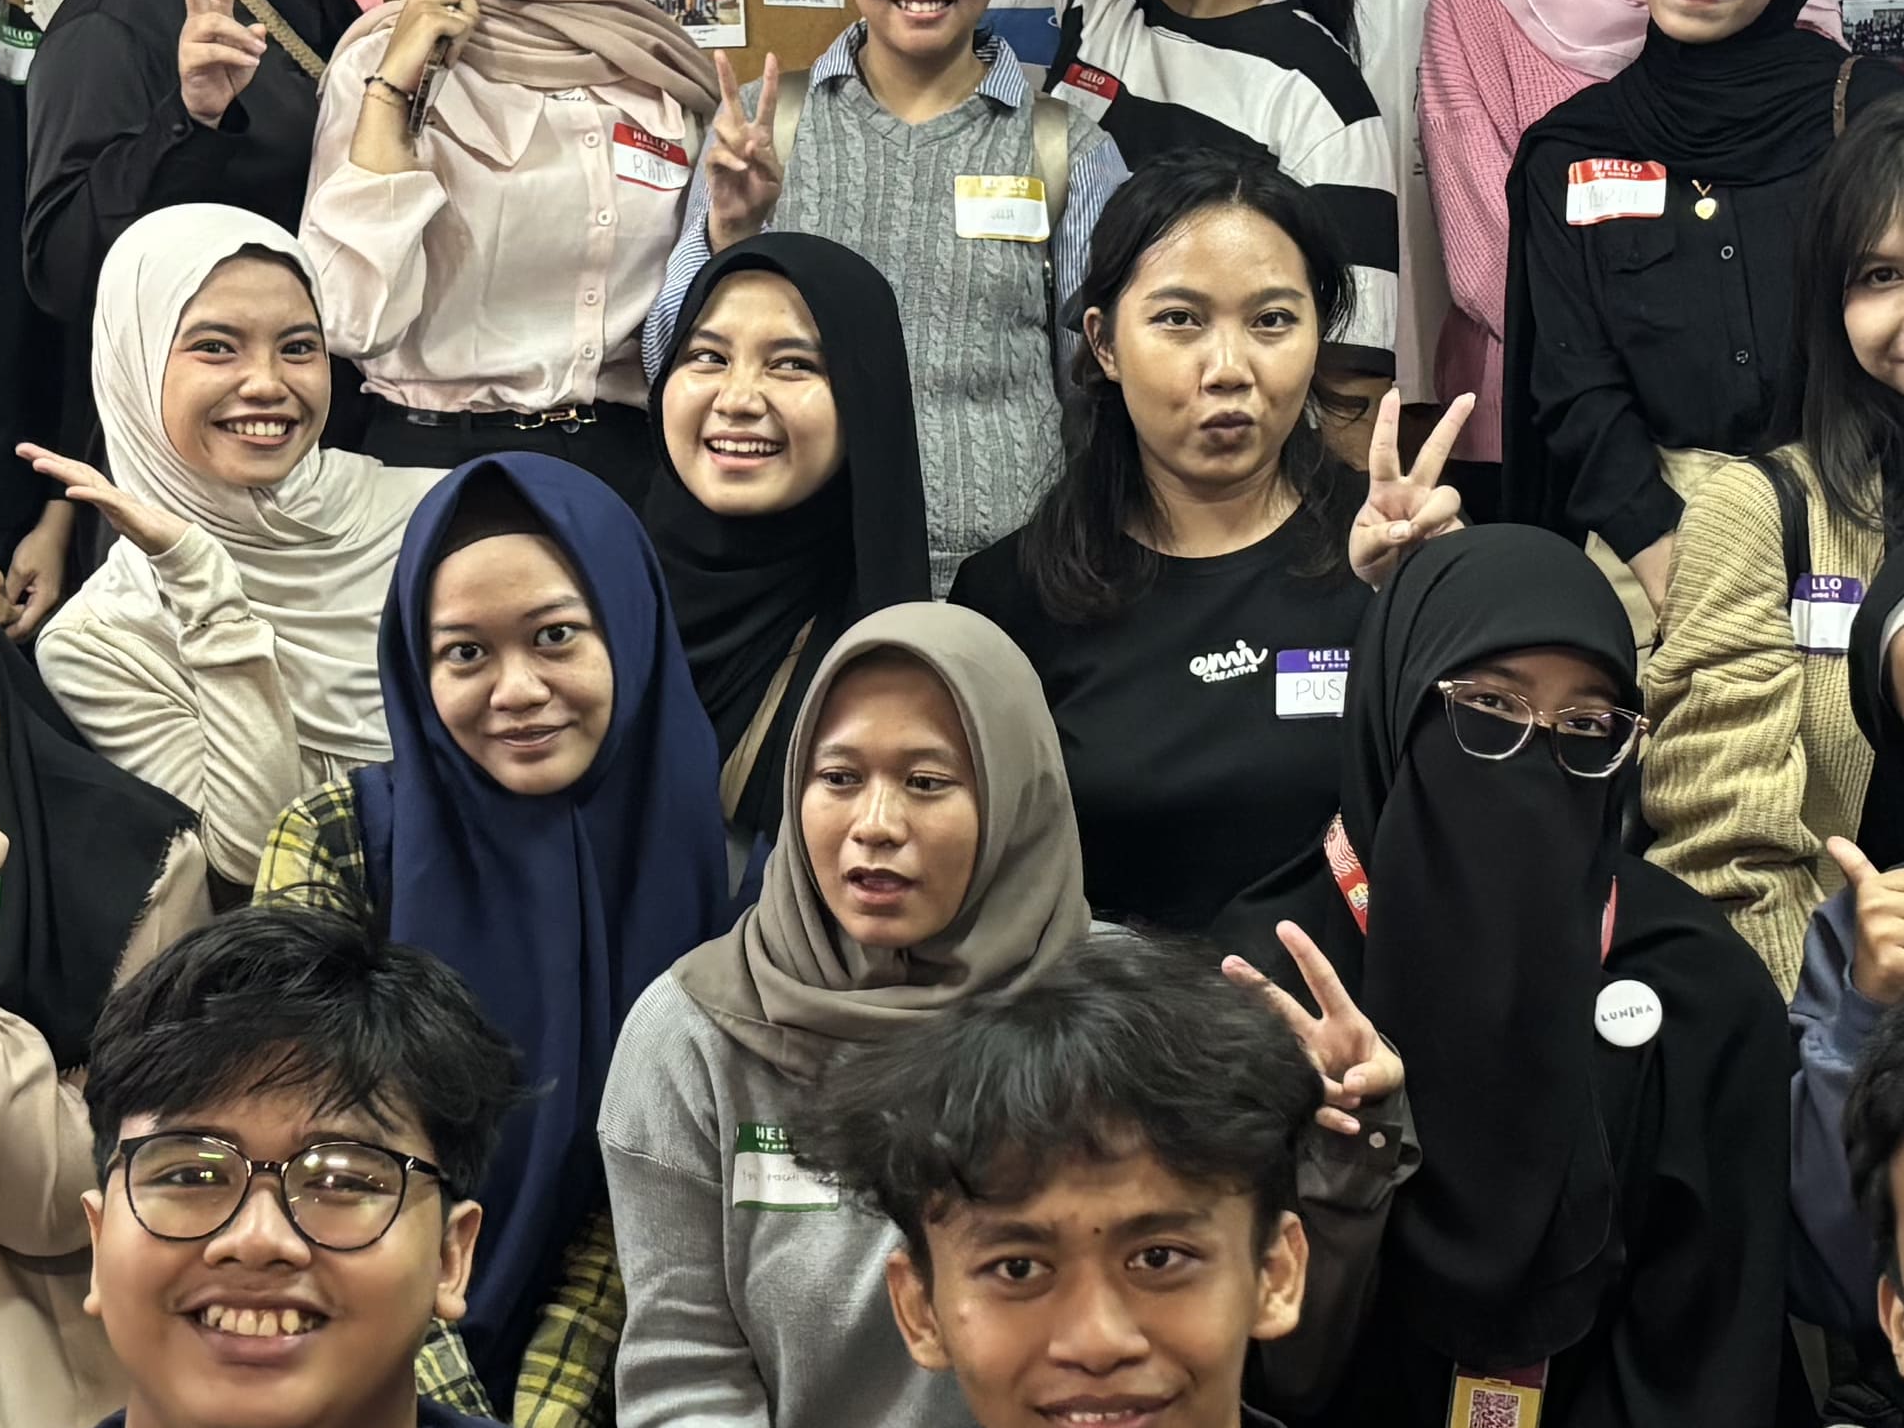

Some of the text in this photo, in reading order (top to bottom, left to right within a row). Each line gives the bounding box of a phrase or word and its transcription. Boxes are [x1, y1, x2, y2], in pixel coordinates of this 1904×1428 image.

[632, 129, 669, 152] HELLO
[1591, 159, 1643, 173] HELLO
[1202, 665, 1259, 683] CREATIVE
[1600, 1004, 1654, 1023] LUMINA
